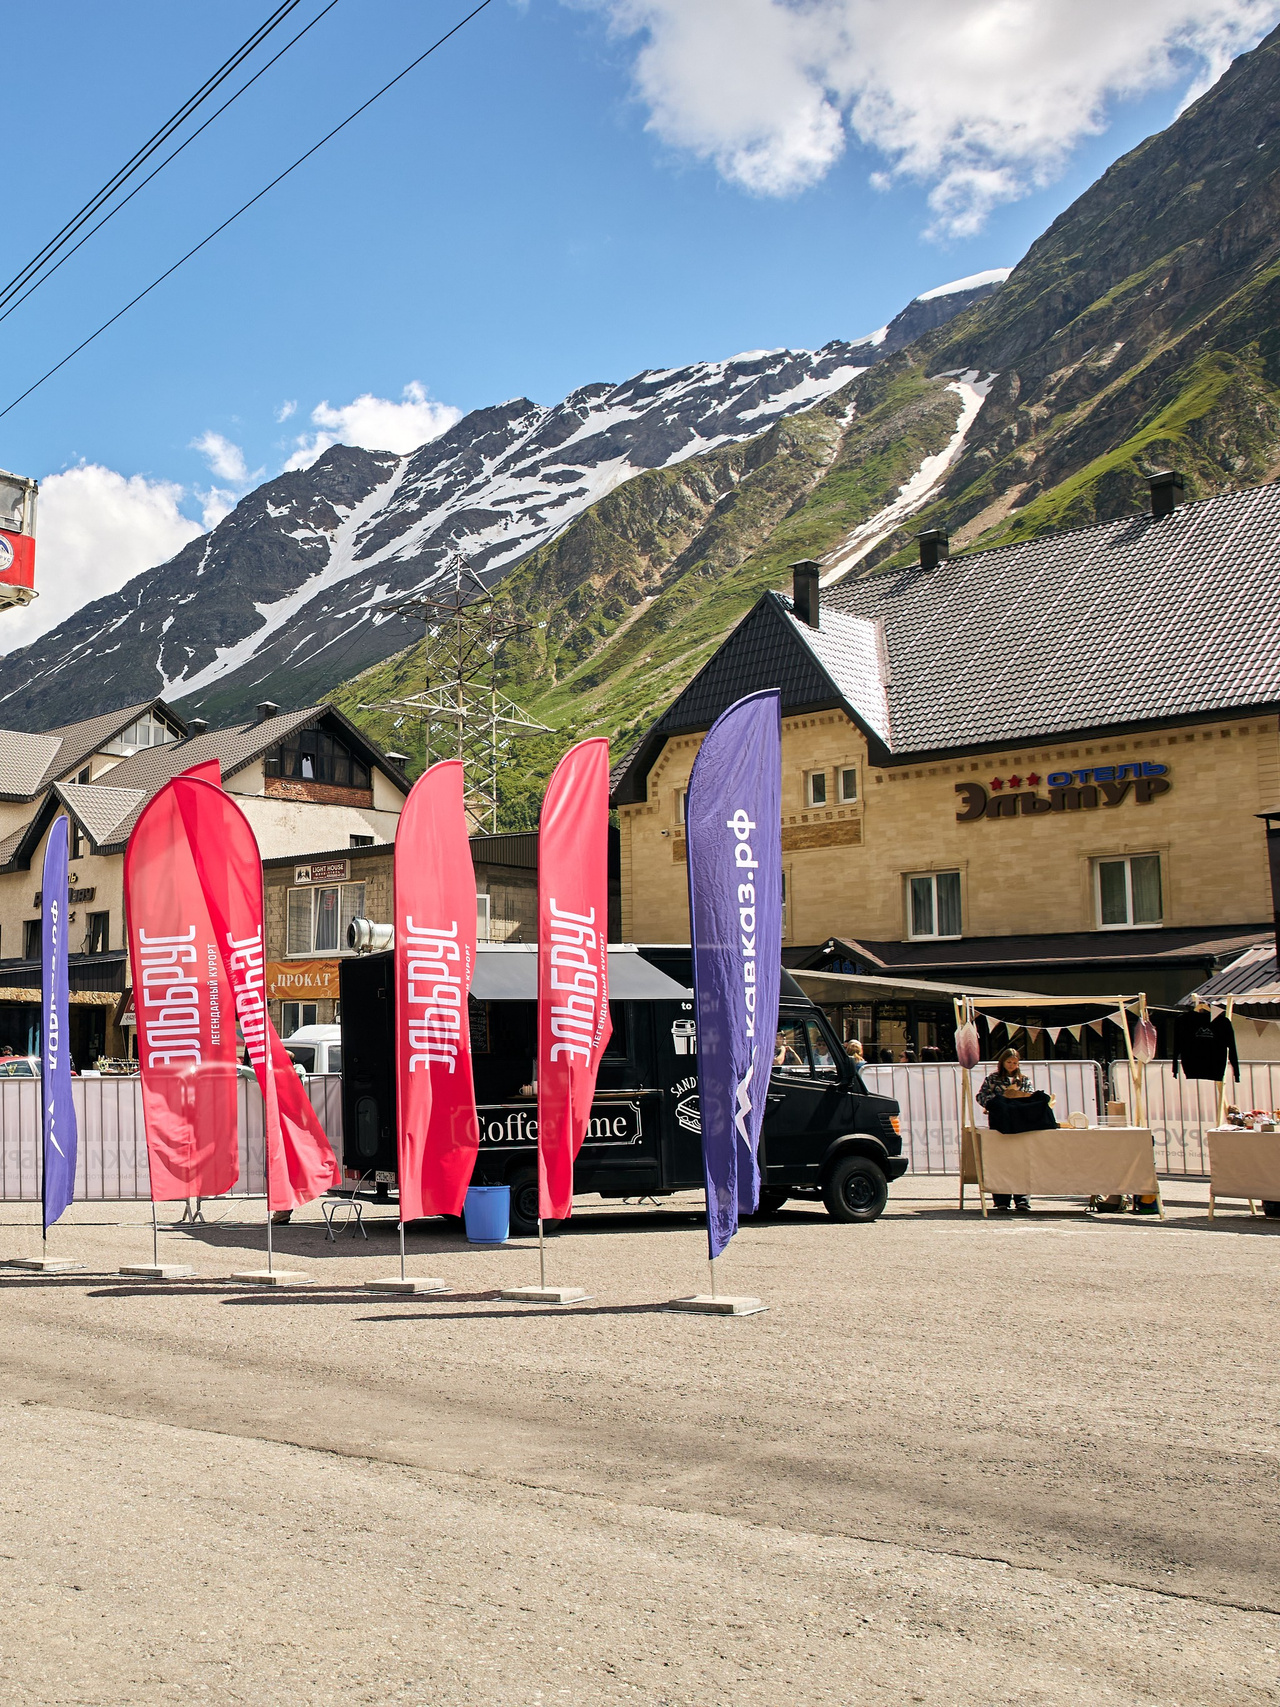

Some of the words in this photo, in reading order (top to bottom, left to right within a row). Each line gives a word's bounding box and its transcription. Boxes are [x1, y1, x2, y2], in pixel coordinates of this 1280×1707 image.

[1047, 761, 1168, 787] ОТЕЛЬ
[727, 809, 759, 1037] кавказ.рф
[207, 944, 219, 978] КУРОРТ
[277, 973, 331, 987] ПРОКАТ
[406, 916, 461, 1074] ЭЛЬБРУС
[550, 898, 598, 1067] ЭЛЬБРУС
[139, 925, 202, 1068] ЭЛЬБРУС
[207, 982, 221, 1045] ЛЕГЕНДАРНЫЙ
[592, 973, 608, 1048] ЛЕГЕНДАРНЫЙ
[681, 1002, 692, 1010] to
